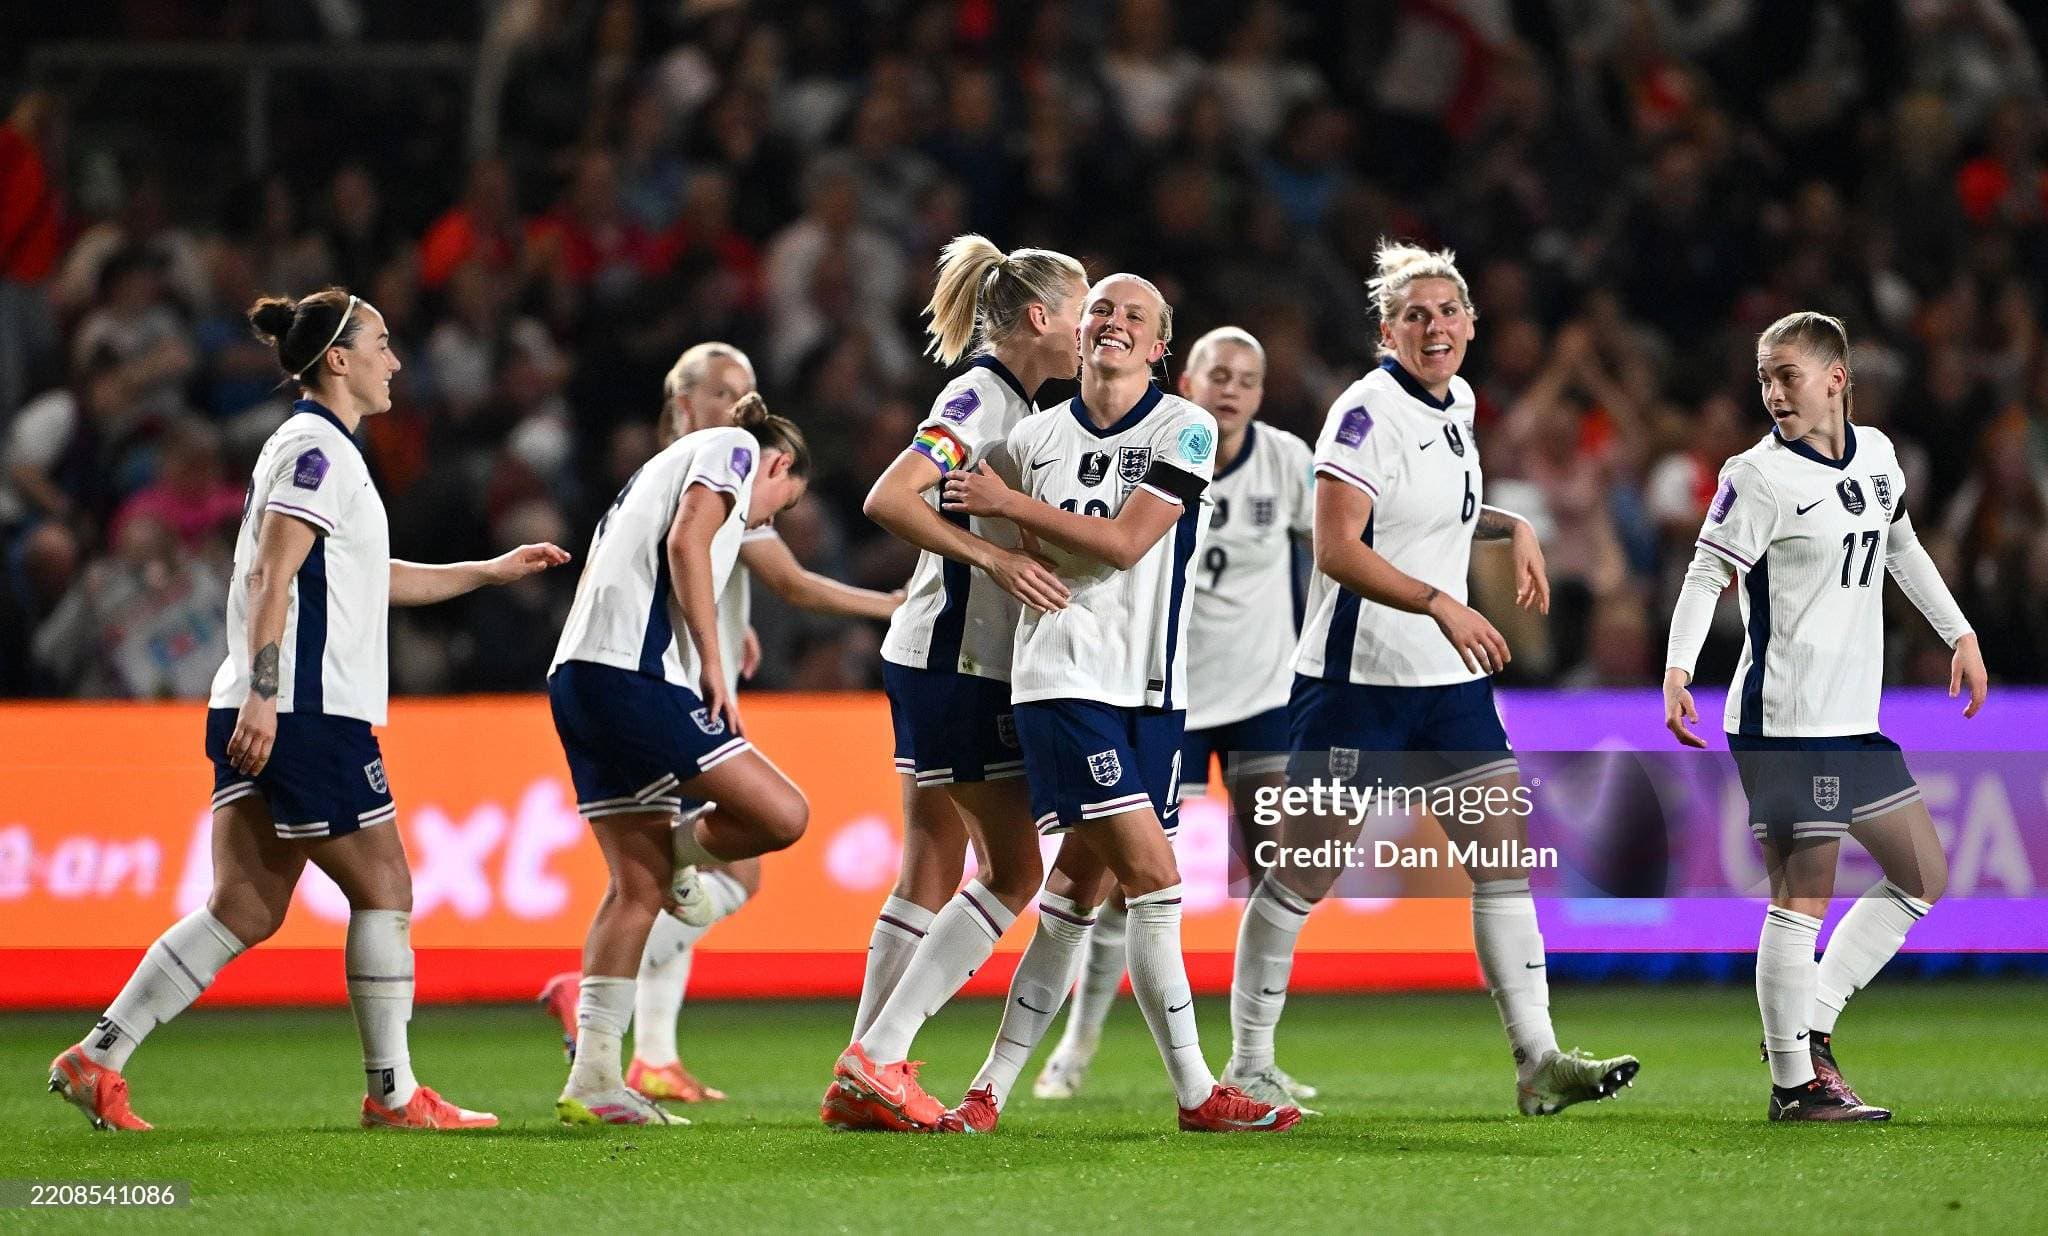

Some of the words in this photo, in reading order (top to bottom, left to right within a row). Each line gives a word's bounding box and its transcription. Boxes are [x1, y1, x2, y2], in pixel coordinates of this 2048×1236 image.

[1461, 470, 1476, 525] 6
[1205, 546, 1227, 588] 9
[1841, 530, 1880, 588] 17
